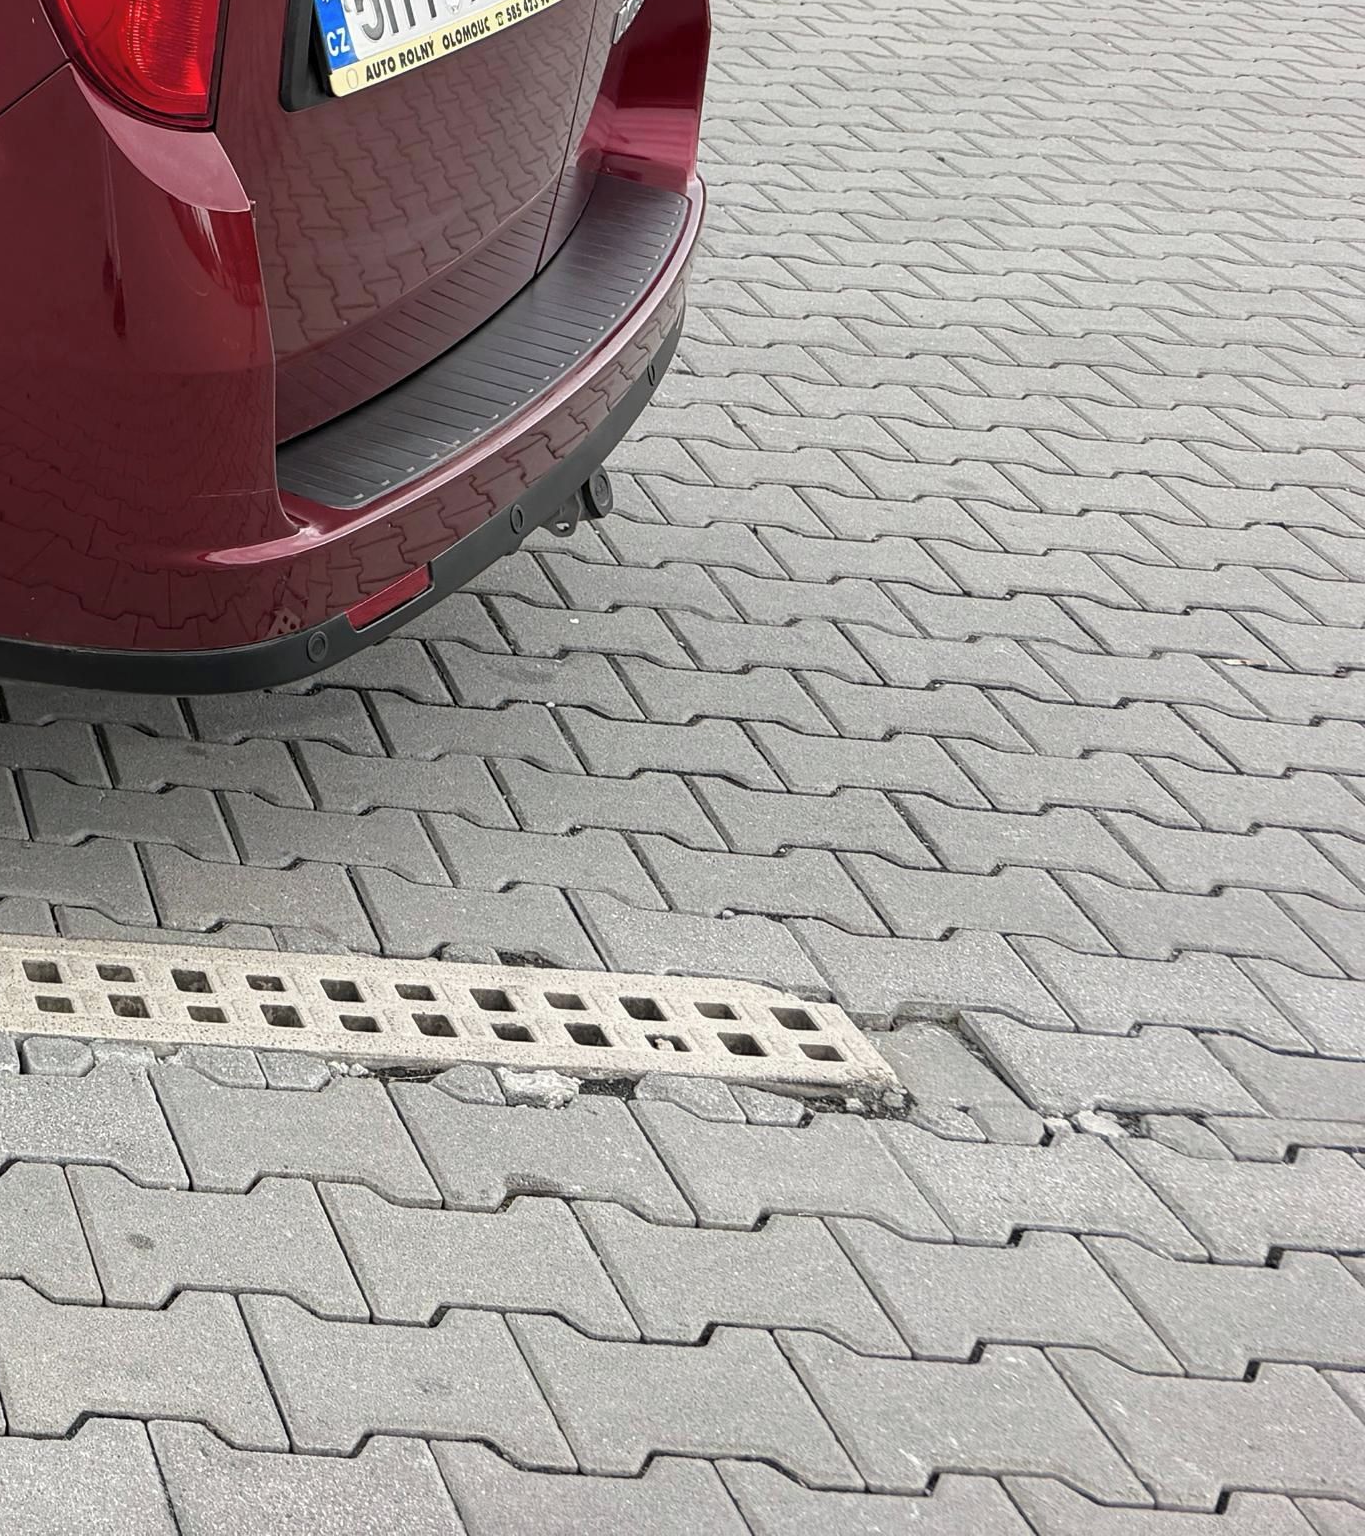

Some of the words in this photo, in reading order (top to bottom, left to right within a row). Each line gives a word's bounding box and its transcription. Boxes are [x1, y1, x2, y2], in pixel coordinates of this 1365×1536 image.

[326, 27, 351, 57] CZ
[365, 56, 396, 82] AUTO
[398, 35, 435, 68] ROLNÝ
[442, 16, 491, 50] OLOMOUC
[505, 2, 522, 23] 585
